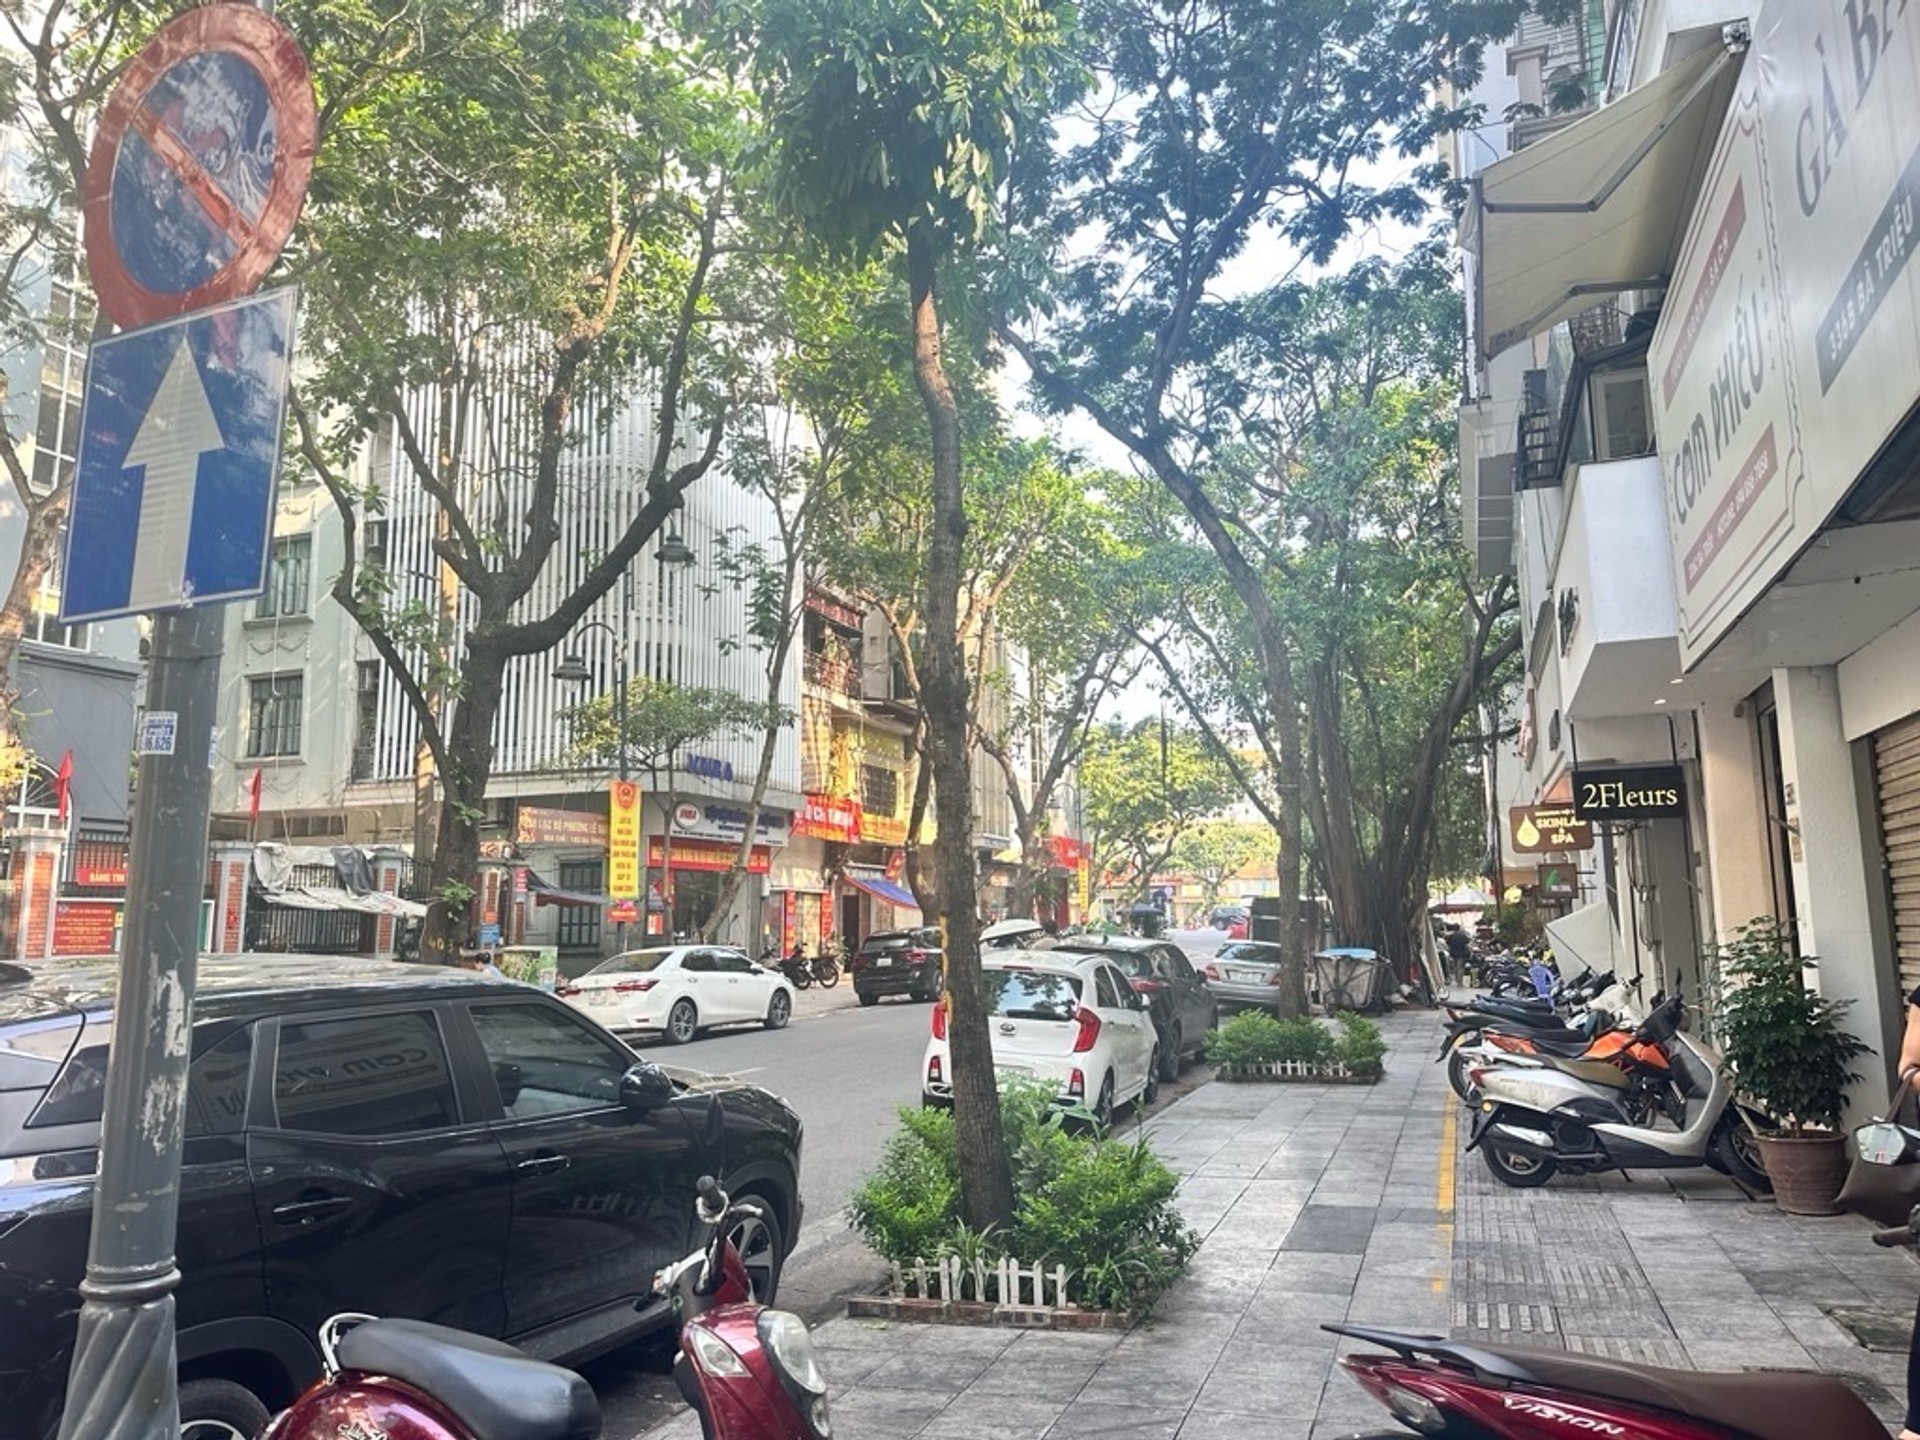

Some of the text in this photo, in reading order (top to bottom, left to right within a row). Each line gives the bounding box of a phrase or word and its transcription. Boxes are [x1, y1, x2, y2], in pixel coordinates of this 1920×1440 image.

[1856, 259, 1875, 314] BÀ
[1875, 194, 1914, 280] TRIỆU
[1582, 782, 1679, 808] 2Fleurs
[1550, 833, 1575, 844] SPA
[1504, 1396, 1626, 1435] VISION
